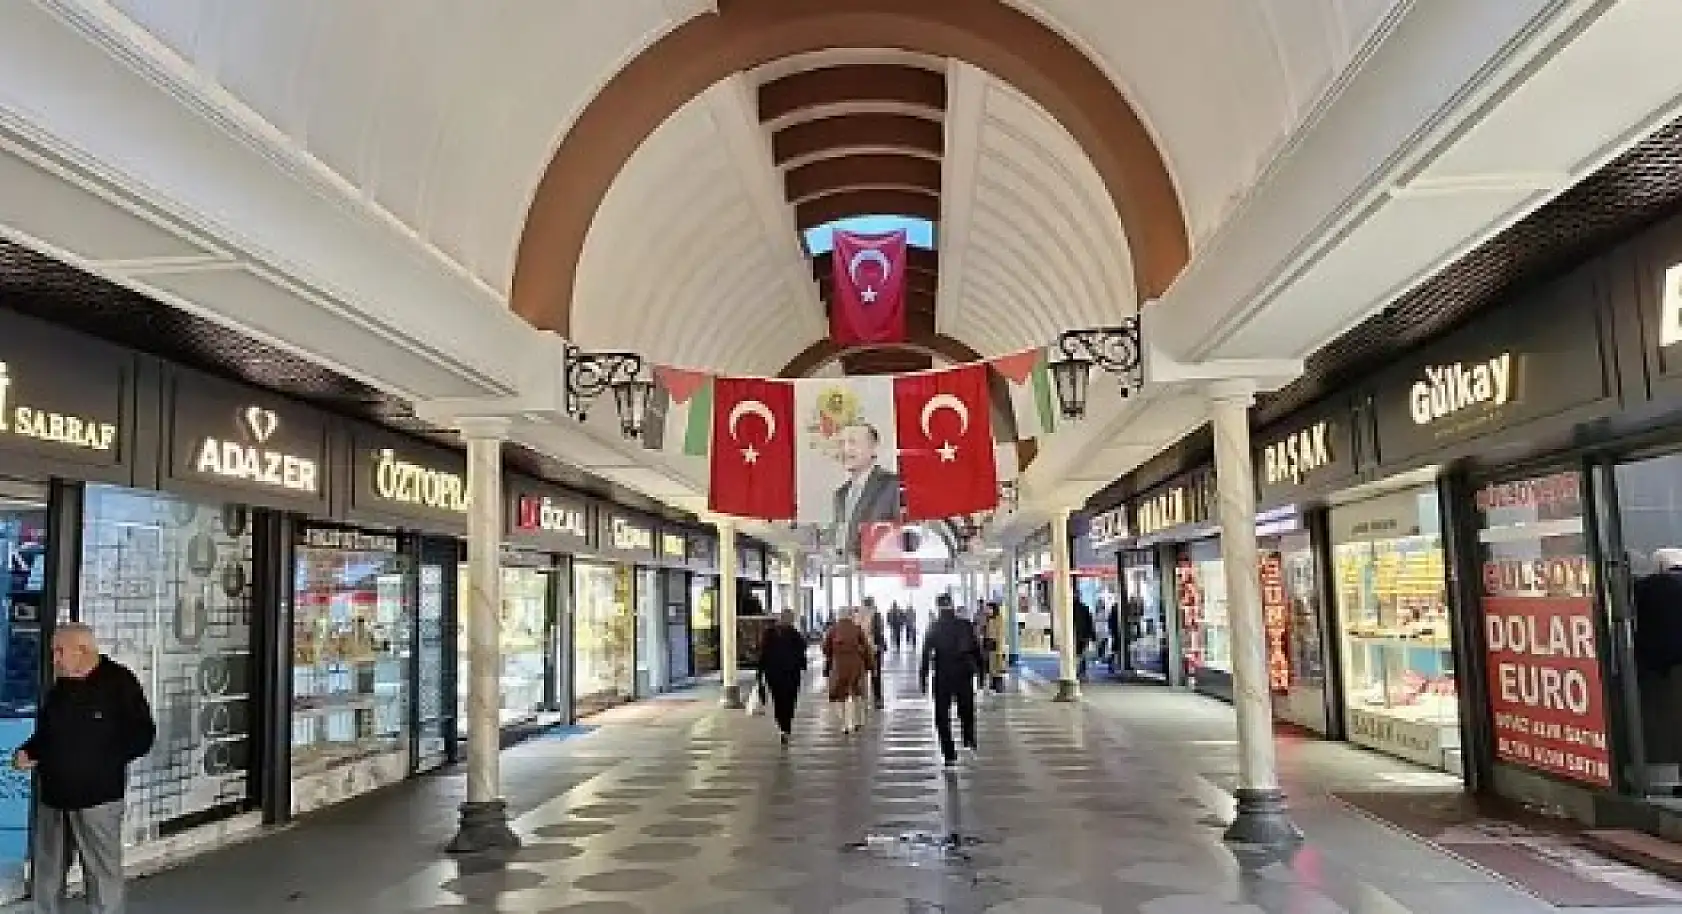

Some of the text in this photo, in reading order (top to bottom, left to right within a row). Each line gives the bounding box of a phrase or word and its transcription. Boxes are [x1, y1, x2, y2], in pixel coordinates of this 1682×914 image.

[14, 406, 116, 450] SARRAF
[1264, 420, 1329, 486] BAŞAK
[198, 436, 317, 493] ADAZER
[541, 496, 586, 537] ÖZAL
[1485, 614, 1597, 660] DOLAR
[1498, 662, 1588, 716] EURO
